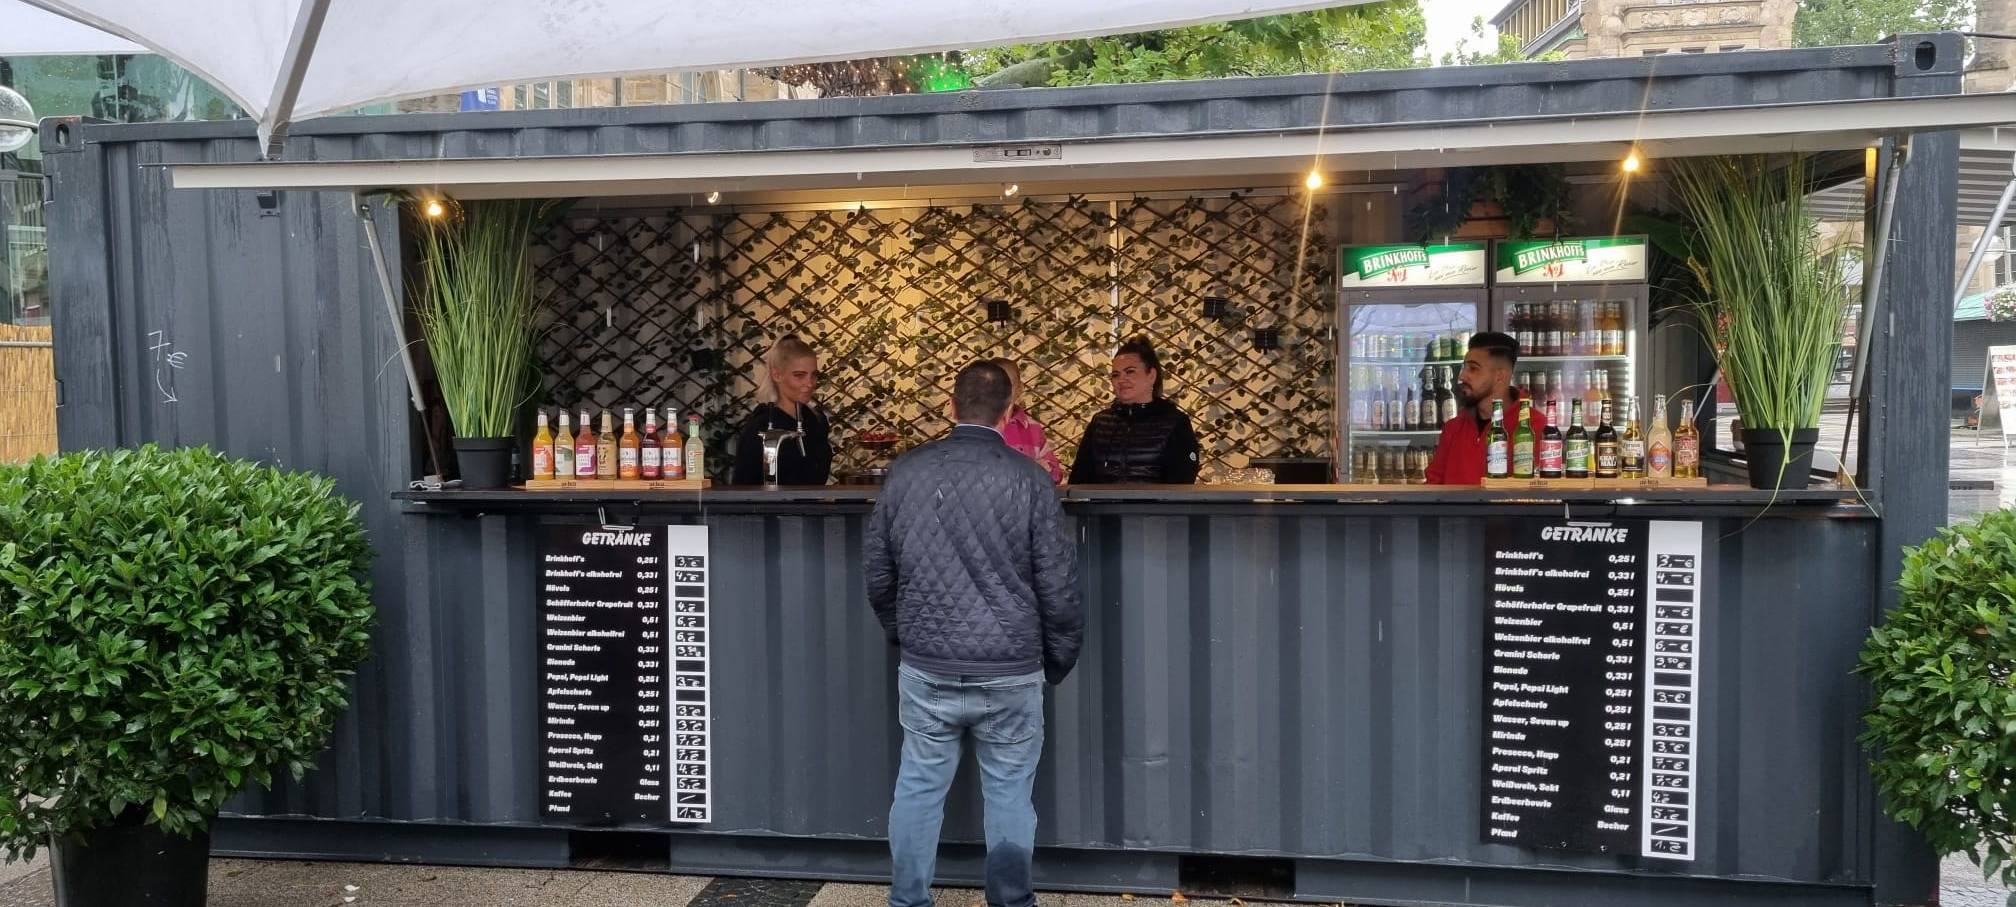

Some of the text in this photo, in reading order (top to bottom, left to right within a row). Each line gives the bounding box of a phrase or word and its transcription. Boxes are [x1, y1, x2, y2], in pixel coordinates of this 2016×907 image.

[582, 530, 652, 546] GETRÄNKE
[1496, 551, 1543, 559] Brinkhoff's
[1609, 555, 1630, 563] 0,25
[1495, 567, 1543, 576] Brinkhoff's
[1608, 572, 1629, 580] 0,33
[1495, 584, 1524, 592] Hövels
[1608, 589, 1629, 597] 0,25
[546, 599, 595, 607] Schöfferhofer
[1495, 600, 1555, 610] Schöfferhofer
[1557, 603, 1602, 612] Grapefruit
[1607, 605, 1629, 614] 0,33
[1495, 617, 1542, 626] Weizenbier
[1613, 622, 1628, 631] 0,5
[642, 631, 654, 639] 0,5
[1495, 633, 1542, 642] Weizenbier
[1543, 636, 1591, 645] alkoholfrei
[1612, 639, 1628, 647] 0,5
[638, 646, 654, 654] 0,33
[1494, 649, 1526, 658] Granini
[1527, 651, 1560, 660] Schorle
[1606, 655, 1628, 664] 0,33
[547, 673, 568, 681] Pepsi,
[590, 674, 608, 682] Light
[1494, 666, 1528, 674] Bionade
[1606, 672, 1627, 680] 0,33
[1493, 682, 1519, 692] Pepsi,
[1521, 684, 1545, 693] Pepsi
[1546, 685, 1568, 694] Light
[1606, 689, 1627, 697] 0,25
[548, 702, 576, 711] Wasser,
[639, 705, 655, 713] 0,25
[1493, 699, 1548, 708] Apfelschorle
[1605, 705, 1628, 714] 0,25
[1493, 715, 1528, 725] Wasser,
[1530, 717, 1556, 725] Seven
[1605, 722, 1626, 731] 0,25
[548, 732, 583, 740] Prosecco,
[584, 733, 602, 741] Hugo
[1492, 731, 1526, 740] Mirinda
[1605, 739, 1626, 747] 0,25
[572, 747, 593, 755] Spritz
[1492, 747, 1535, 759] Prosecco,
[1536, 750, 1559, 760] Hugo
[1610, 756, 1626, 764] 0,2
[549, 761, 585, 770] Weißwein,
[645, 764, 656, 772] 0,1
[1492, 763, 1523, 772] Aperol
[1522, 766, 1548, 775] Spritz
[1610, 772, 1625, 781] 0,2
[1492, 780, 1537, 791] Weißwein,
[1539, 783, 1559, 792] Sekt
[1611, 789, 1625, 798] 0,1
[1492, 796, 1552, 807] Erdbeerbowle
[1491, 812, 1520, 821] Kaffee
[1491, 828, 1517, 837] Pfand
